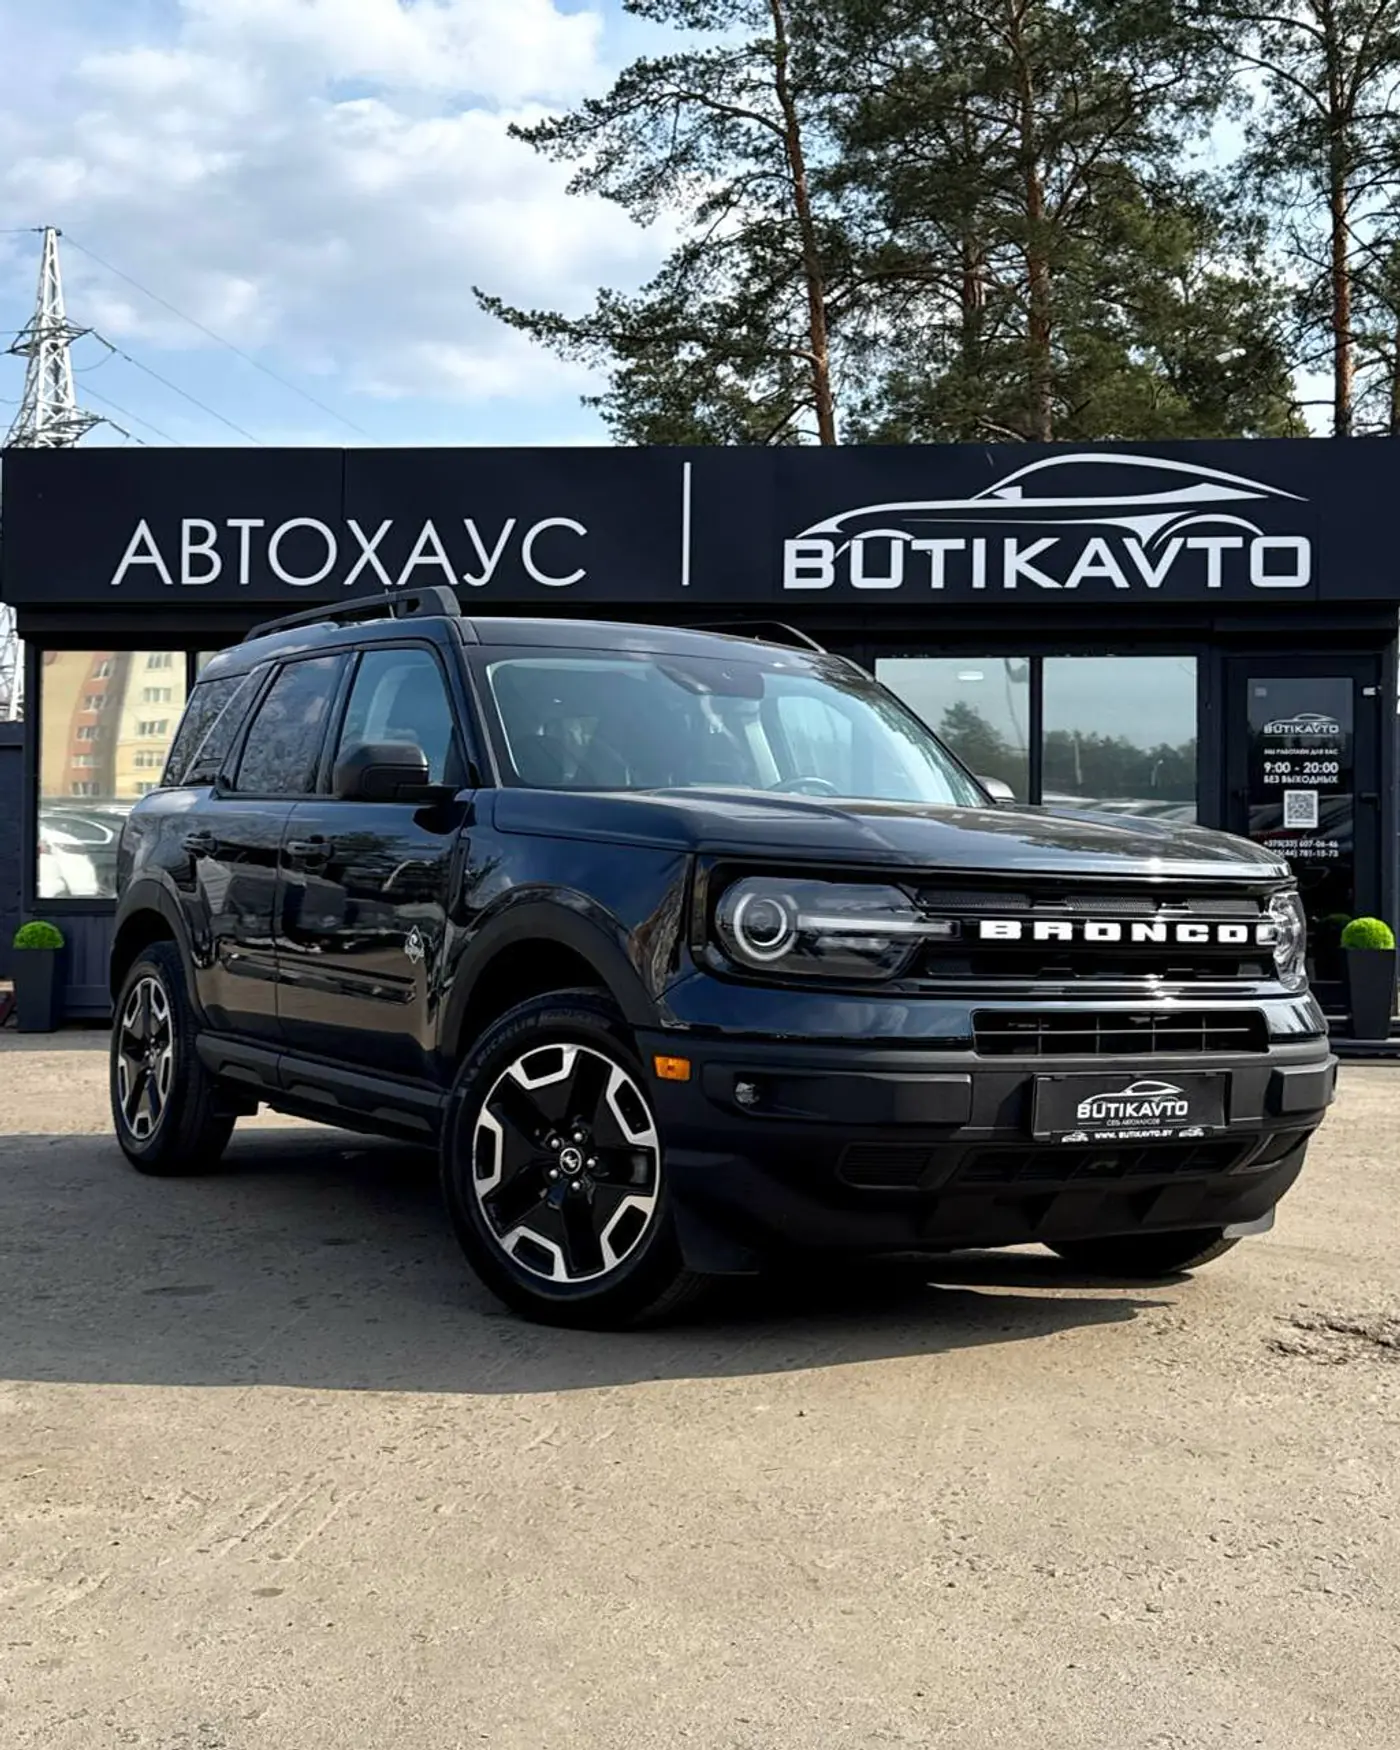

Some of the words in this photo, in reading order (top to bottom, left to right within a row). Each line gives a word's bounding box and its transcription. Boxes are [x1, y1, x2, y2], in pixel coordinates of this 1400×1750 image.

[112, 517, 588, 587] АВТОХАУС
[783, 537, 1311, 590] BUTIKAVTO
[1263, 724, 1340, 734] BUTIKAVTO
[1263, 761, 1291, 774] 9:00
[1303, 761, 1339, 774] 20:00
[1263, 775, 1280, 784] БЕЗ
[1281, 775, 1339, 785] ВЫХОДНЫХ
[979, 919, 1249, 943] BRONCO
[1076, 1100, 1189, 1119] BUTIKAVTO
[1118, 1129, 1173, 1138] BUTIKAVTO.BY
